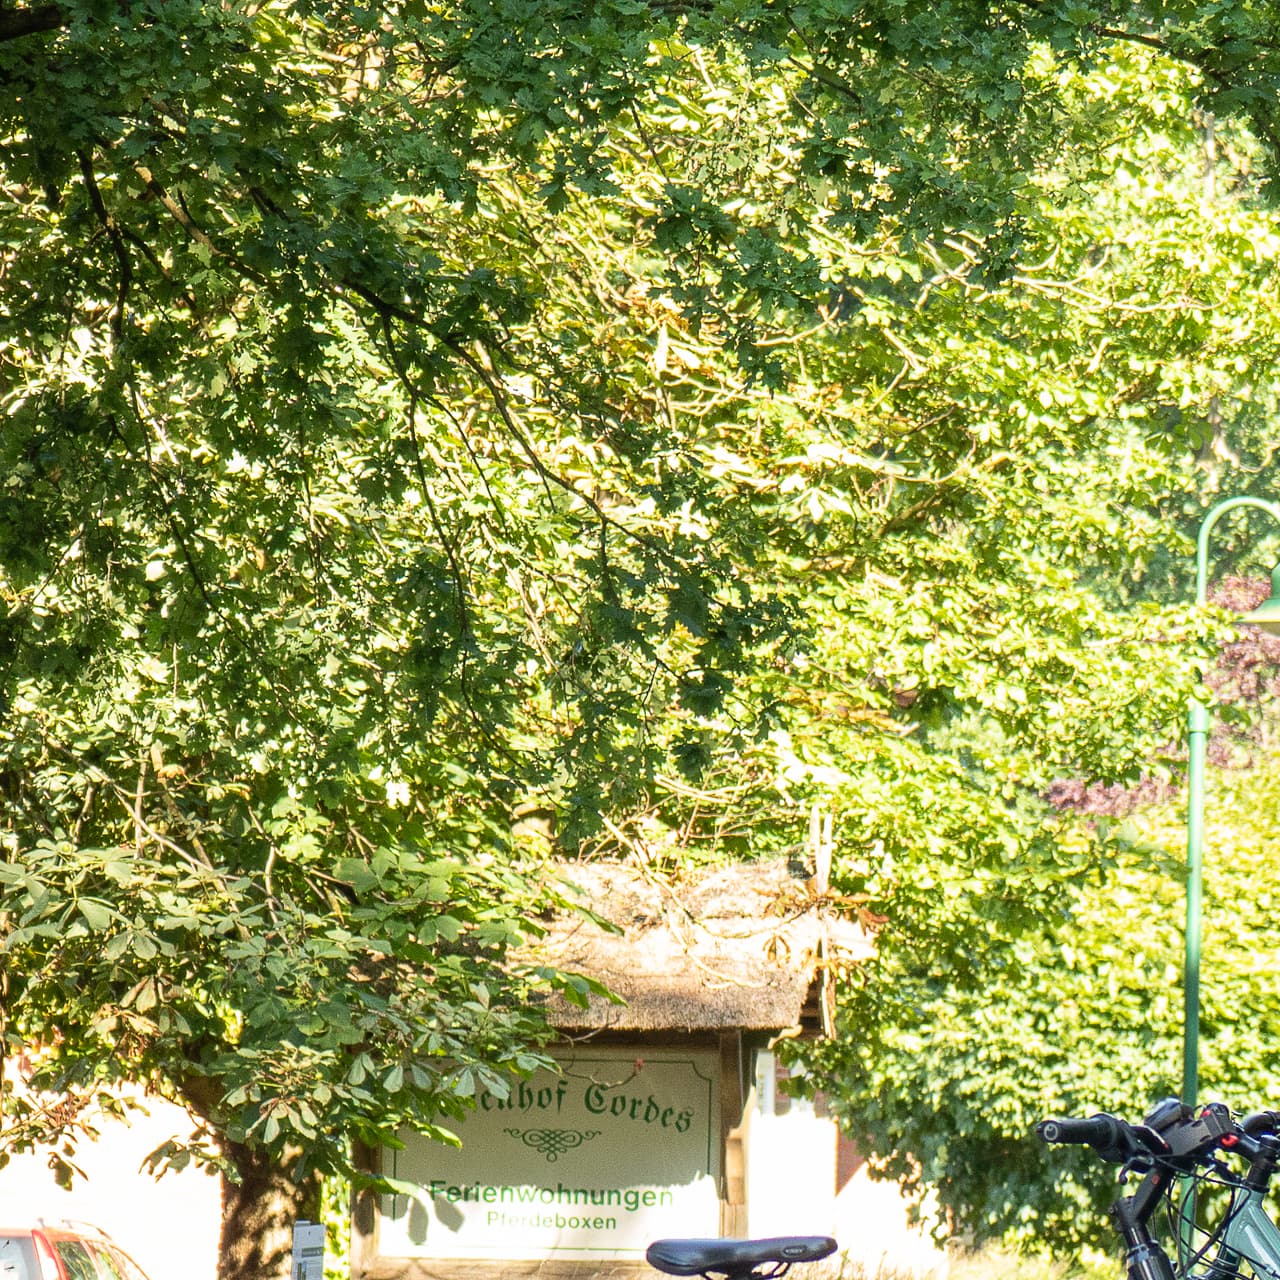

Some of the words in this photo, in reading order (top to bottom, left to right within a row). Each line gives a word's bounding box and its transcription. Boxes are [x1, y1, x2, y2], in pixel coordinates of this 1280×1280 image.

[584, 1083, 694, 1133] Cordes
[429, 1178, 674, 1211] Ferienwohnungen
[486, 1210, 617, 1230] Pferdeboxen
